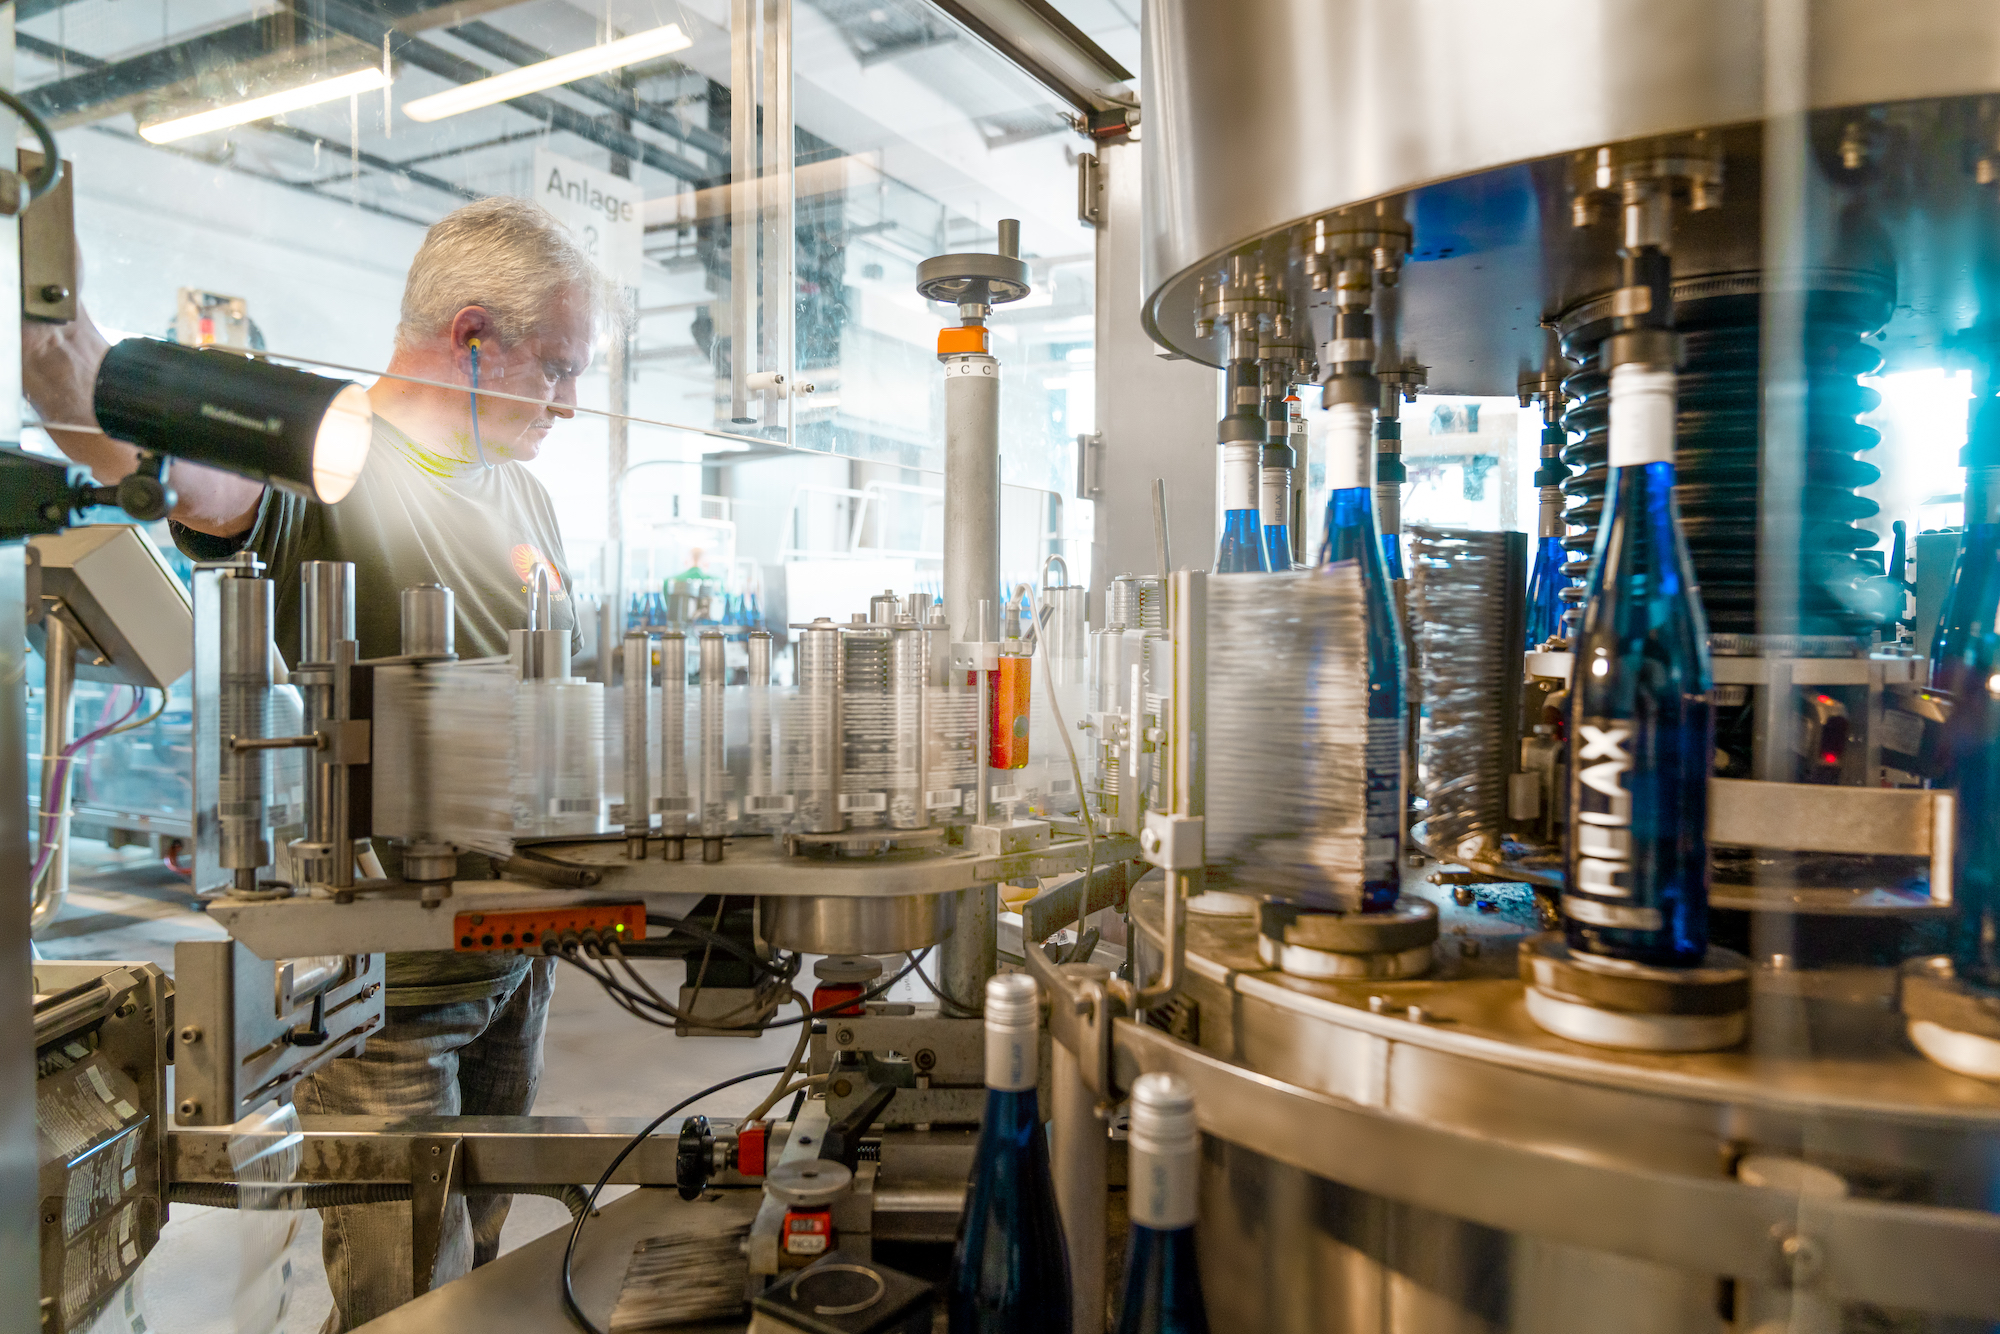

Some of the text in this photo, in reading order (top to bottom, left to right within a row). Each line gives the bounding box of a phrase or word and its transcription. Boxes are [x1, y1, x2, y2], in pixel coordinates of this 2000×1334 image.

[546, 167, 633, 222] Anlage
[961, 365, 970, 374] C
[983, 365, 991, 375] C
